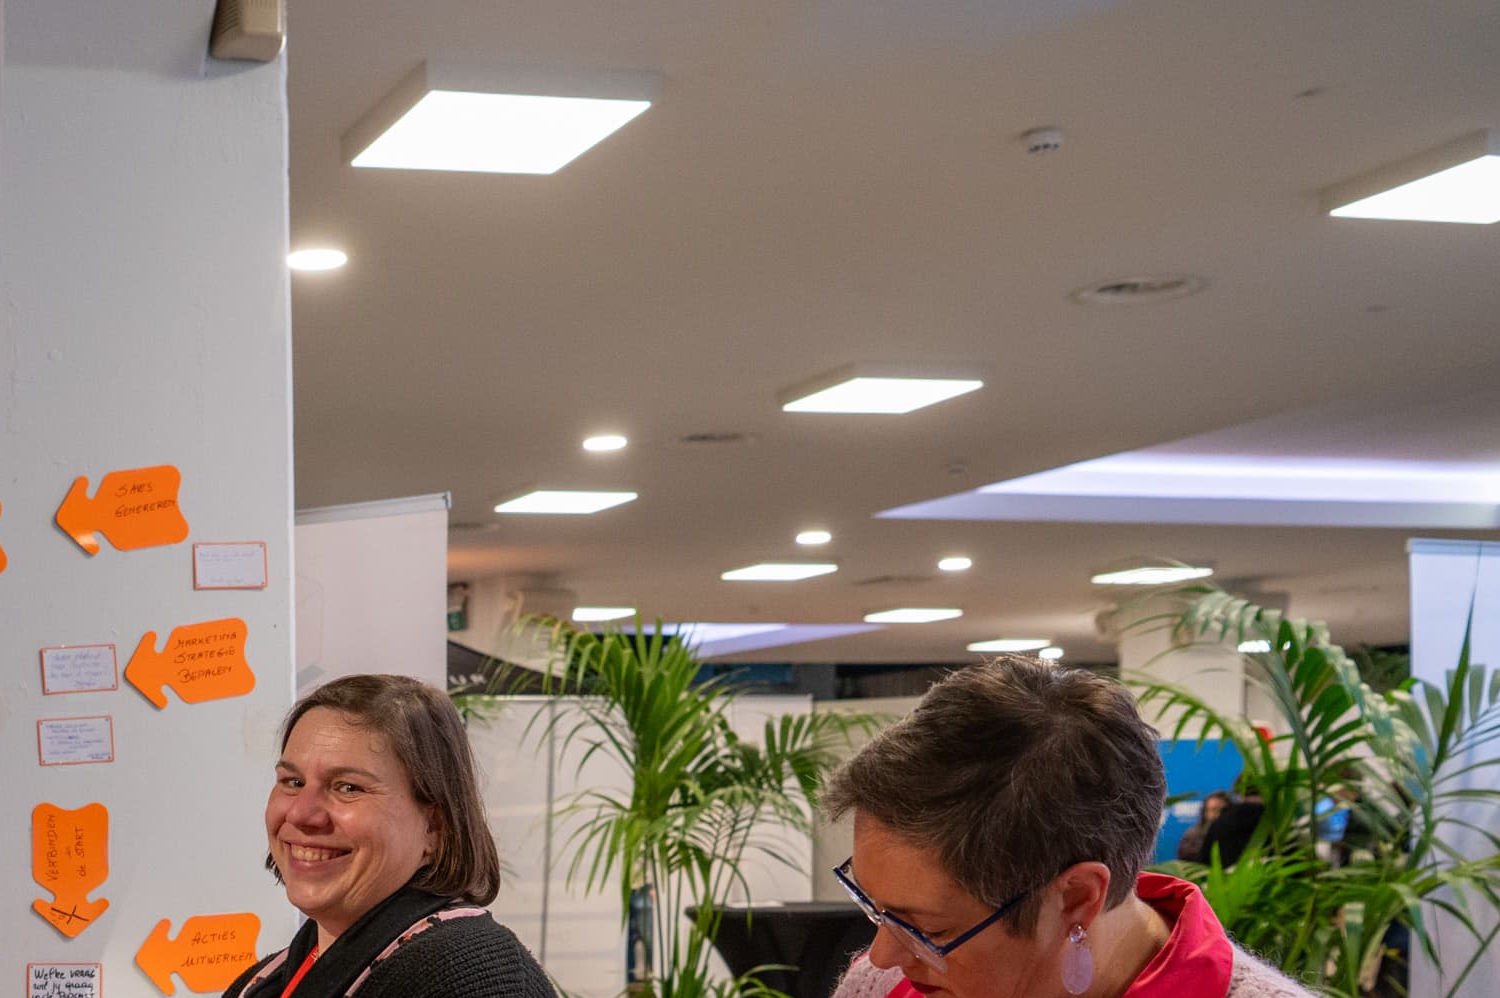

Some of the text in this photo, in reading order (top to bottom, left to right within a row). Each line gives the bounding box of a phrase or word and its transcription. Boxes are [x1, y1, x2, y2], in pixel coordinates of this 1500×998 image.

[173, 645, 235, 664] STRATEGIE
[177, 665, 232, 684] BEPALEN
[191, 930, 236, 947] ACTIES
[180, 952, 253, 967] UITWERKEN
